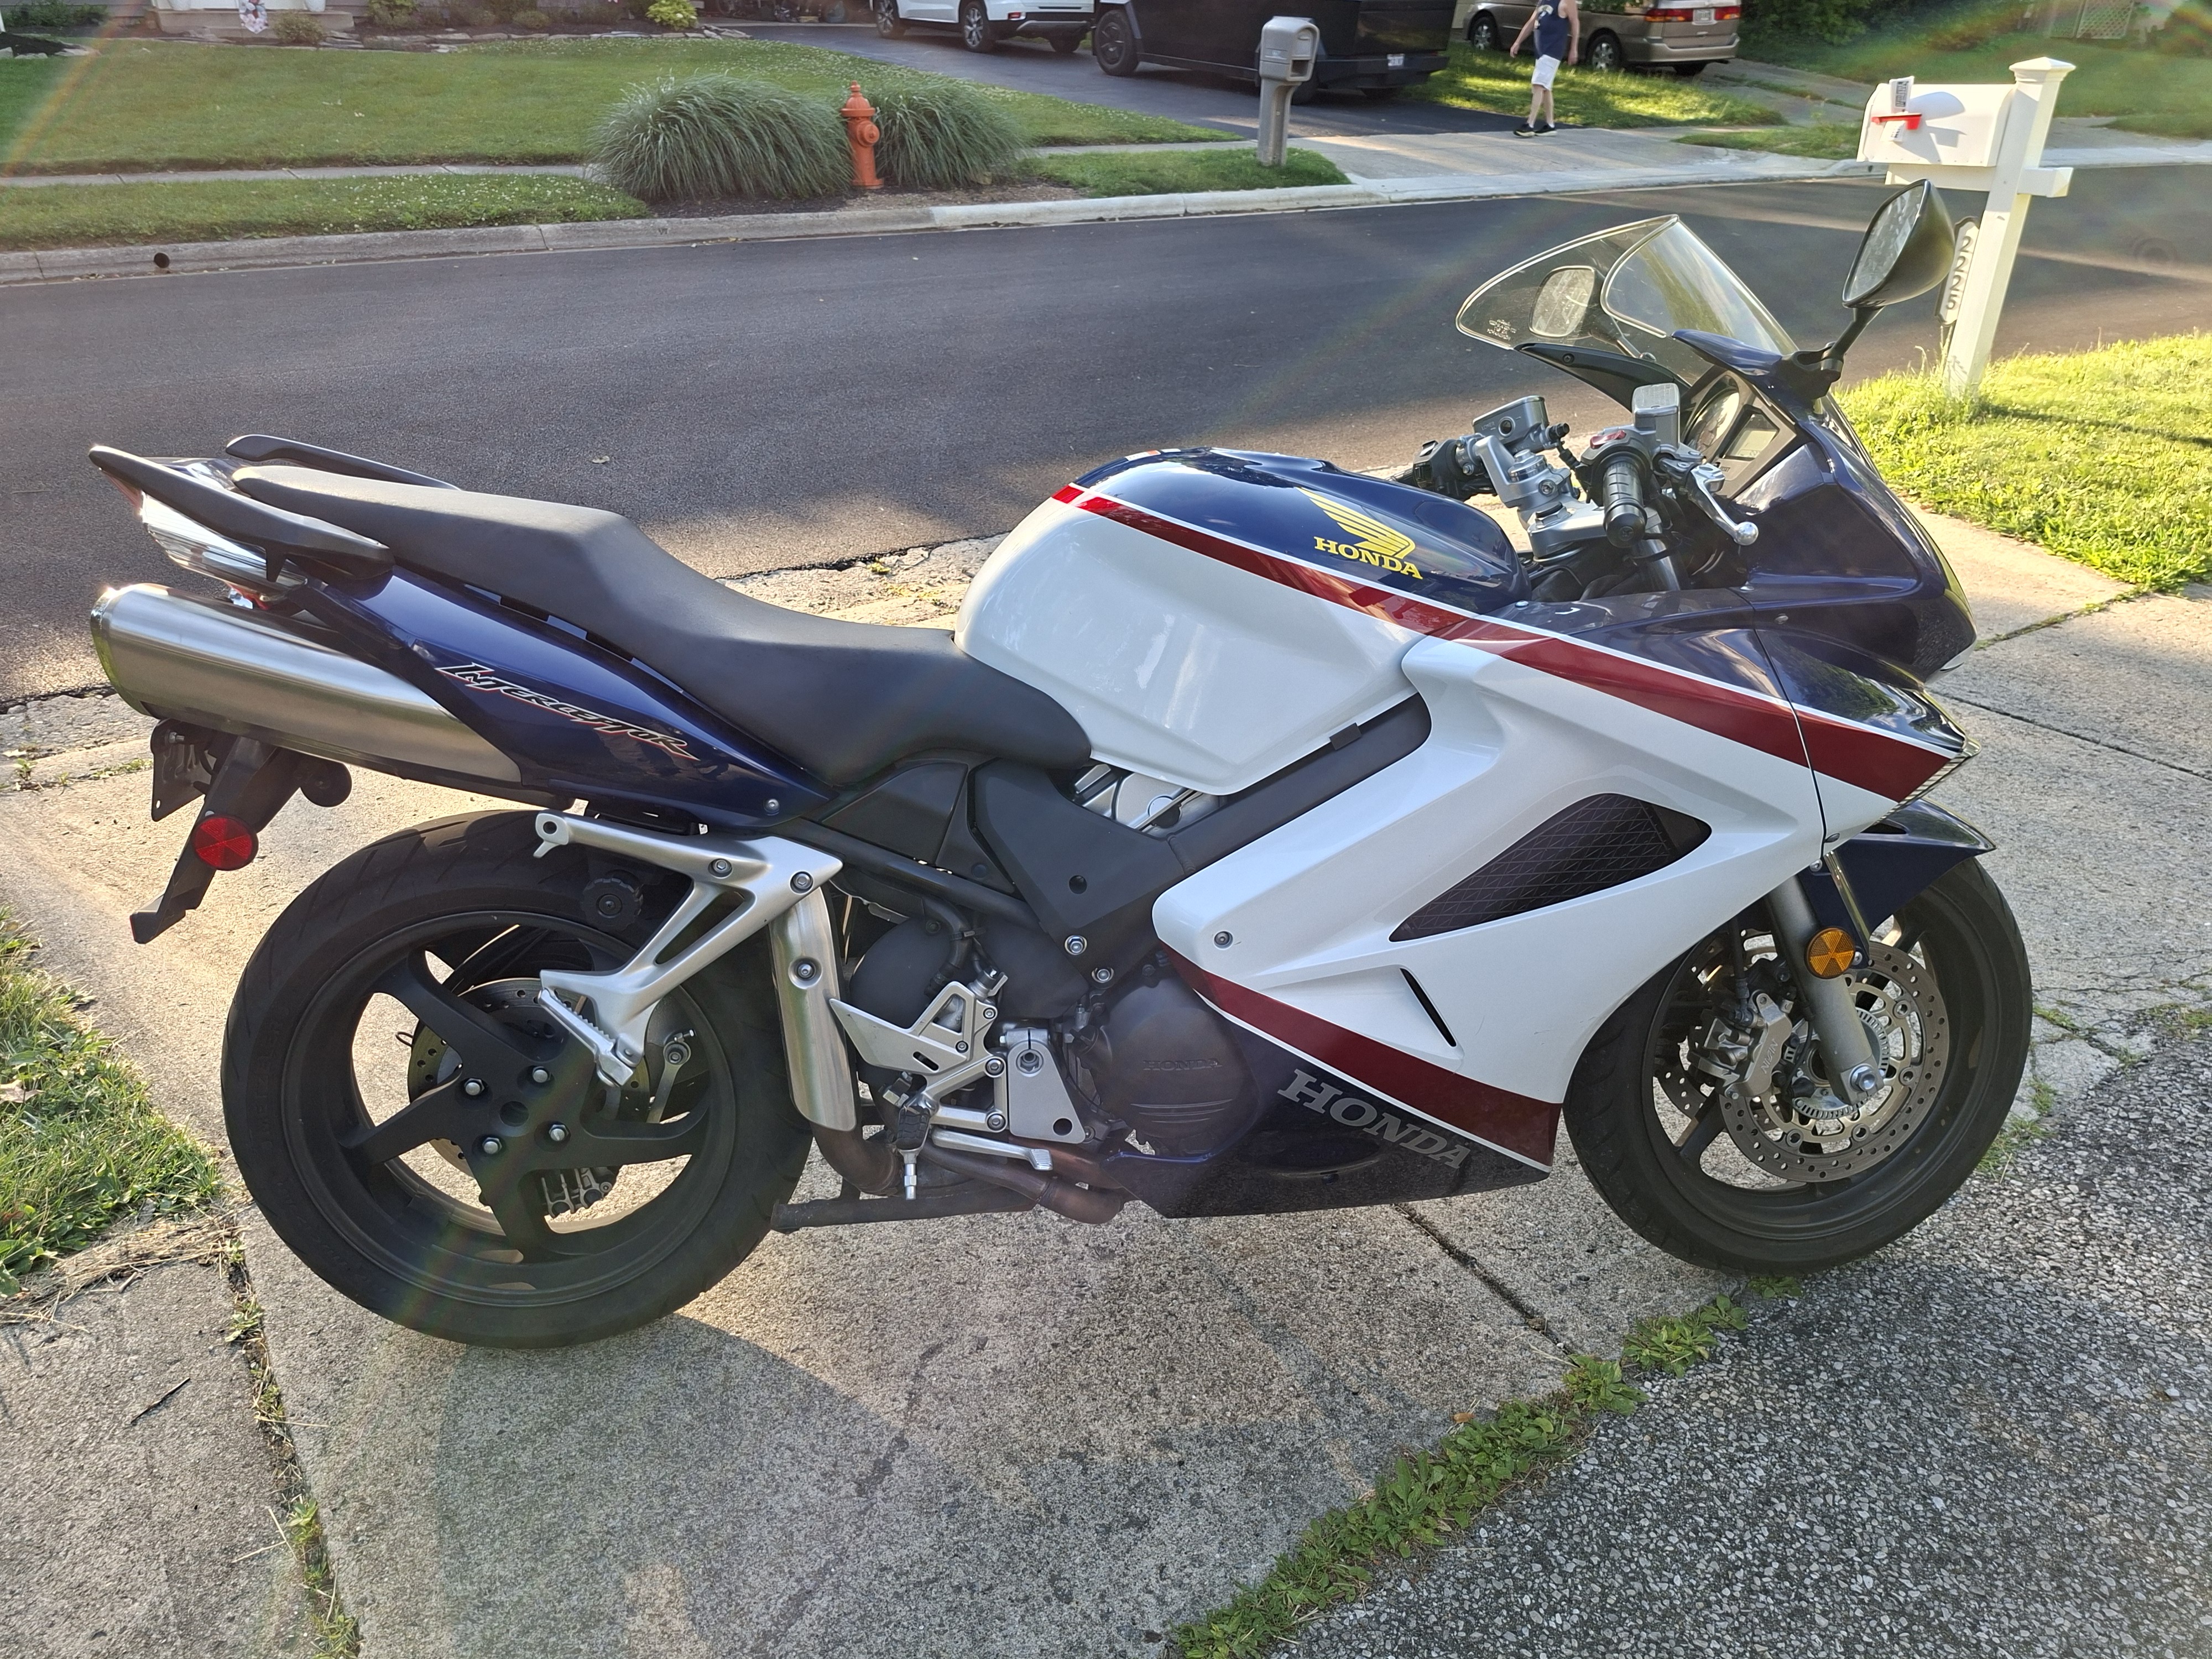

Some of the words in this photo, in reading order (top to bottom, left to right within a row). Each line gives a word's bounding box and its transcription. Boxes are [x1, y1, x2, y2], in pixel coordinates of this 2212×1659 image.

[1944, 236, 1972, 310] 2225
[1314, 536, 1423, 580] HONDA
[435, 662, 701, 761] INTERCEPTOR
[1142, 1057, 1223, 1071] HONDA
[1761, 1038, 1778, 1074] NISSIN
[1277, 1068, 1472, 1170] HONDA
